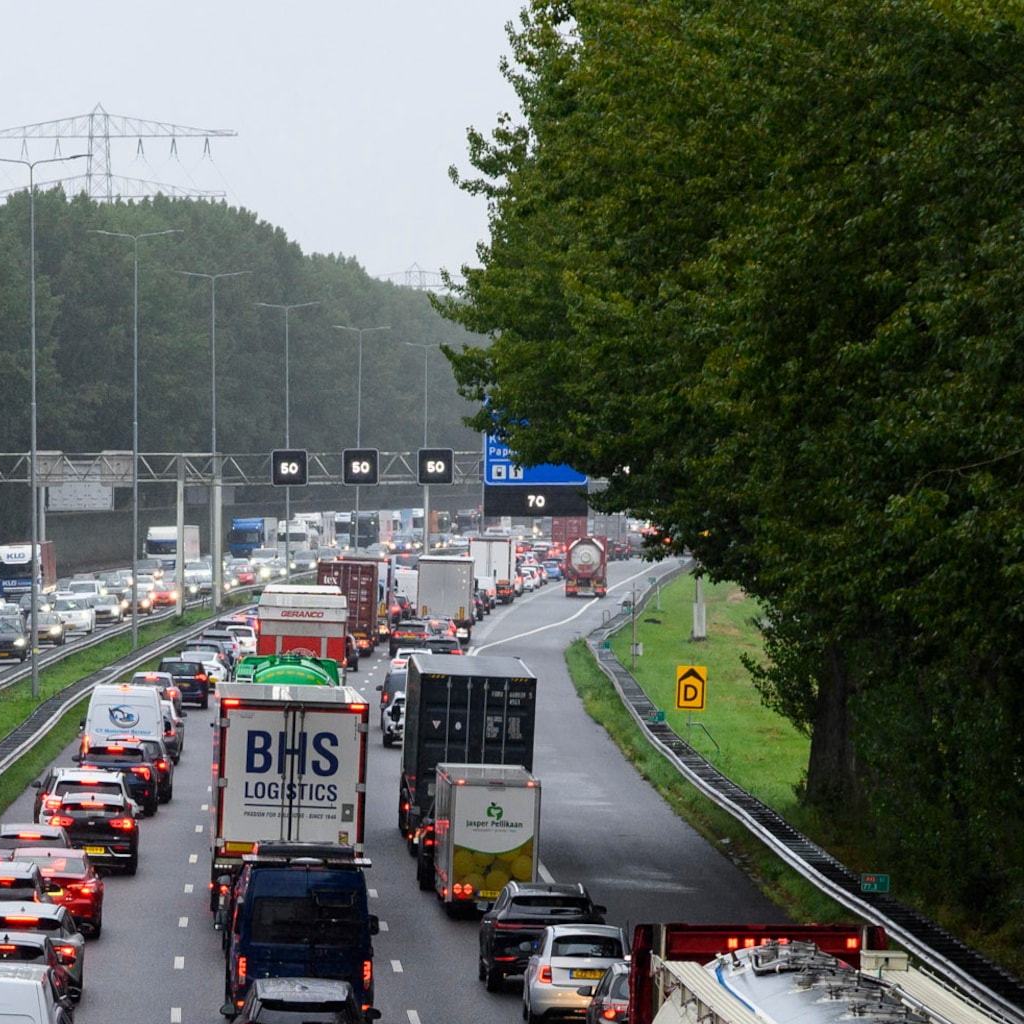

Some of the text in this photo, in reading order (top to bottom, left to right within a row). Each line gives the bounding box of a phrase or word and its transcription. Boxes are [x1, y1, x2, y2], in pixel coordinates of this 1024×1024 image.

[280, 463, 299, 474] 50
[352, 462, 370, 473] 50
[427, 461, 445, 473] 50
[527, 495, 545, 507] 70
[323, 575, 338, 584] tex
[281, 610, 324, 618] GERANCO
[684, 684, 698, 701] D
[245, 730, 339, 776] BHS
[244, 781, 338, 802] LOGISTICS
[466, 819, 489, 828] Jasper
